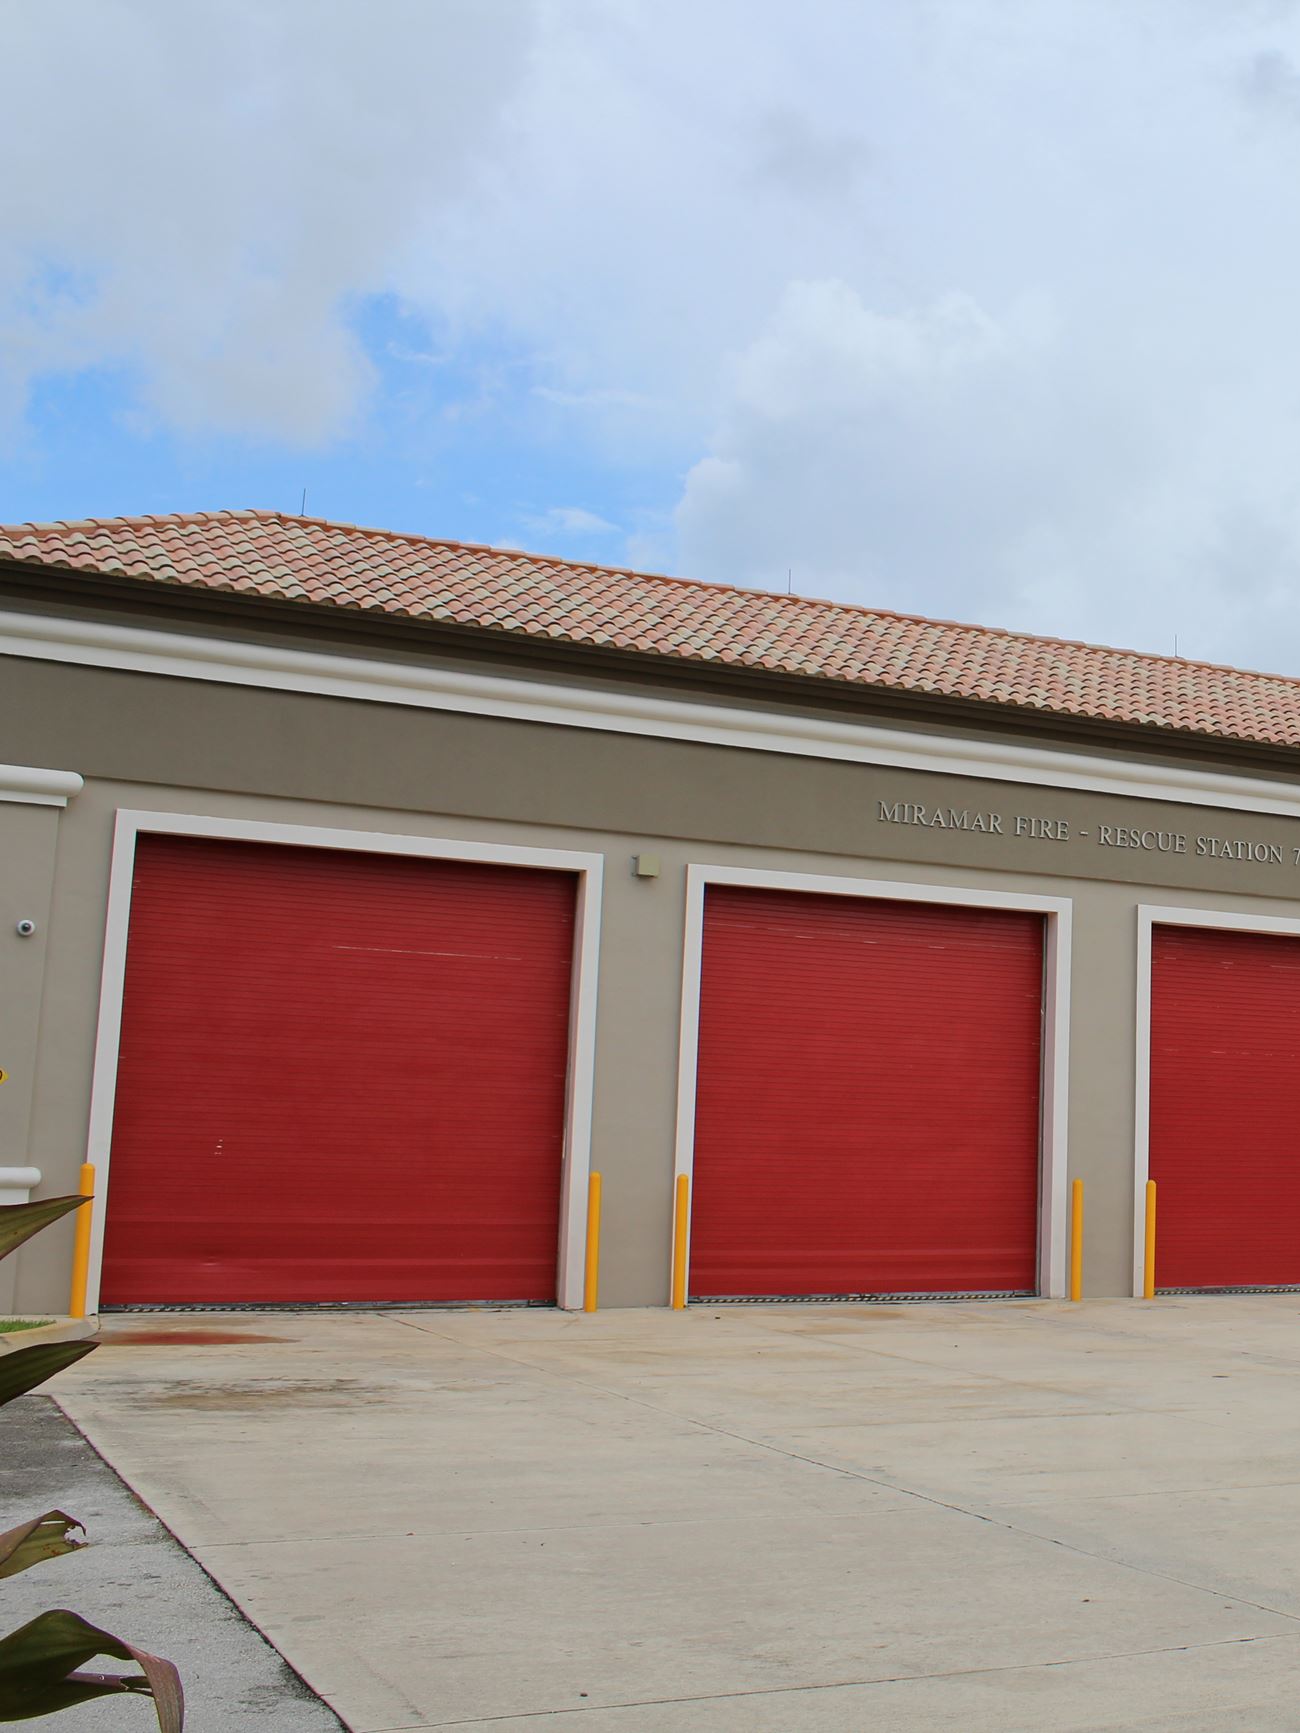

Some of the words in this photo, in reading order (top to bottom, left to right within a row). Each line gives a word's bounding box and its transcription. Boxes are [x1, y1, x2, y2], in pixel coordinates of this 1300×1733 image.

[878, 800, 1004, 835] MIRAMAR
[1014, 816, 1069, 841] FIRE
[1098, 825, 1187, 853] RESCUE
[1196, 836, 1283, 864] STATION
